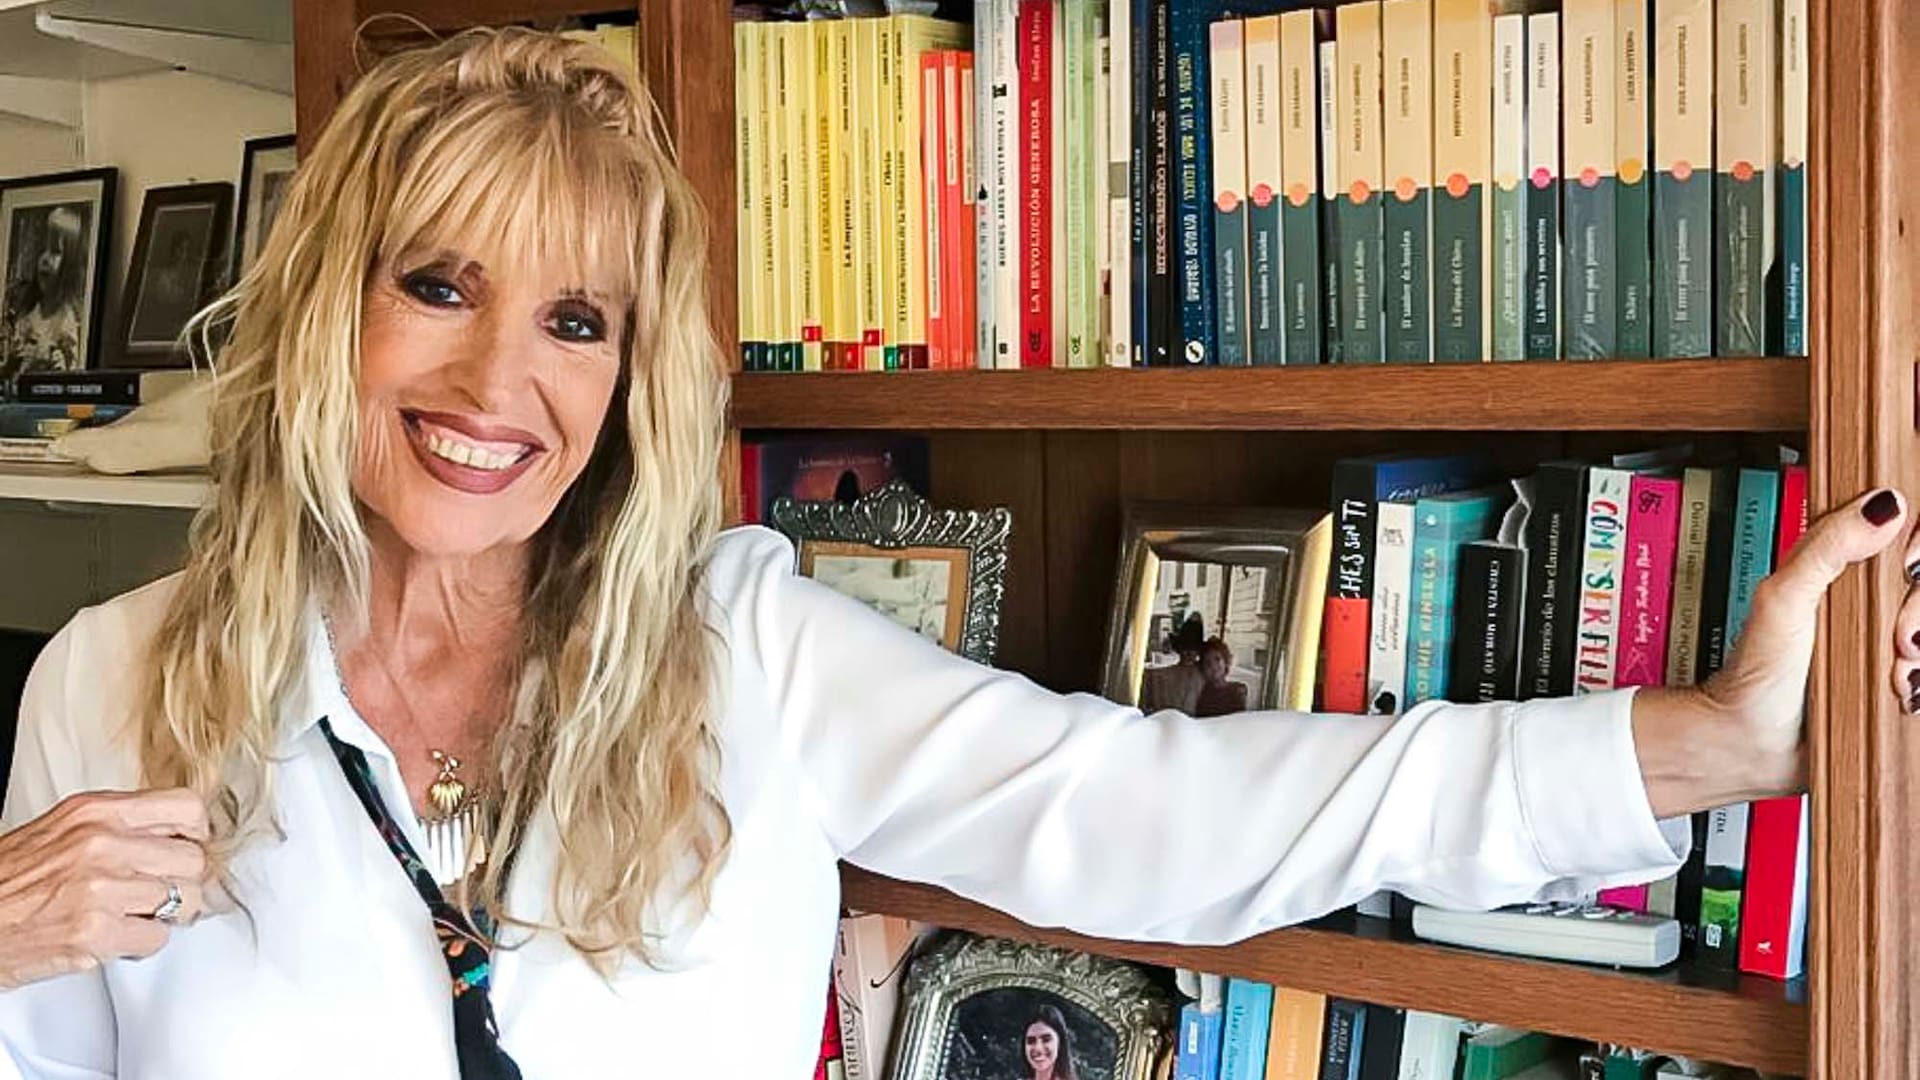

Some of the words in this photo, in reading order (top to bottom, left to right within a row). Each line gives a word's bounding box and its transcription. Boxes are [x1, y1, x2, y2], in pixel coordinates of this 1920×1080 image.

[996, 119, 1005, 186] MISTERIOSA
[1030, 98, 1041, 185] GENEROSA
[997, 188, 1006, 220] AIRES
[1155, 168, 1167, 275] REDESCUBRIENDO
[998, 222, 1007, 267] BUENOS
[1028, 188, 1042, 291] REVOLUCIÓN
[1030, 293, 1041, 313] LA
[1535, 281, 1547, 310] Biblia
[1535, 312, 1547, 323] La
[1342, 499, 1368, 521] TI
[1545, 512, 1561, 577] claustros
[1419, 547, 1438, 633] KINSELLA
[1487, 559, 1502, 619] CRISTINA
[1543, 580, 1556, 599] los
[1543, 602, 1555, 620] de
[1484, 622, 1498, 675] MORATÓ
[1537, 622, 1553, 678] silencio
[1534, 679, 1549, 694] El
